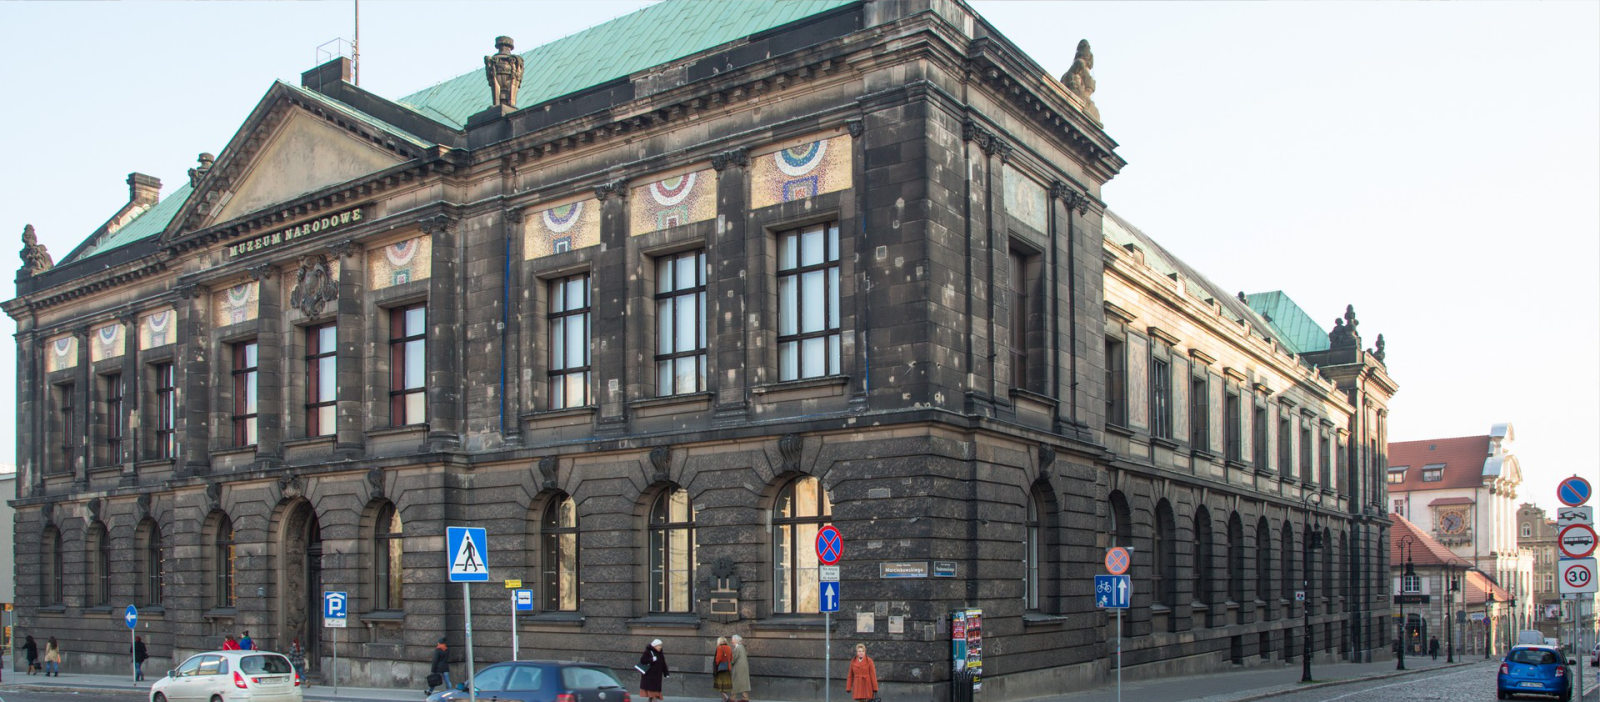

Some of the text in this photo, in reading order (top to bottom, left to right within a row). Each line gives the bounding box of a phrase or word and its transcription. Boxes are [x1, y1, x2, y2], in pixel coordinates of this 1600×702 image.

[229, 208, 361, 257] MUZEUM NARODOWE
[1569, 570, 1588, 583] 30
[328, 598, 342, 615] P
